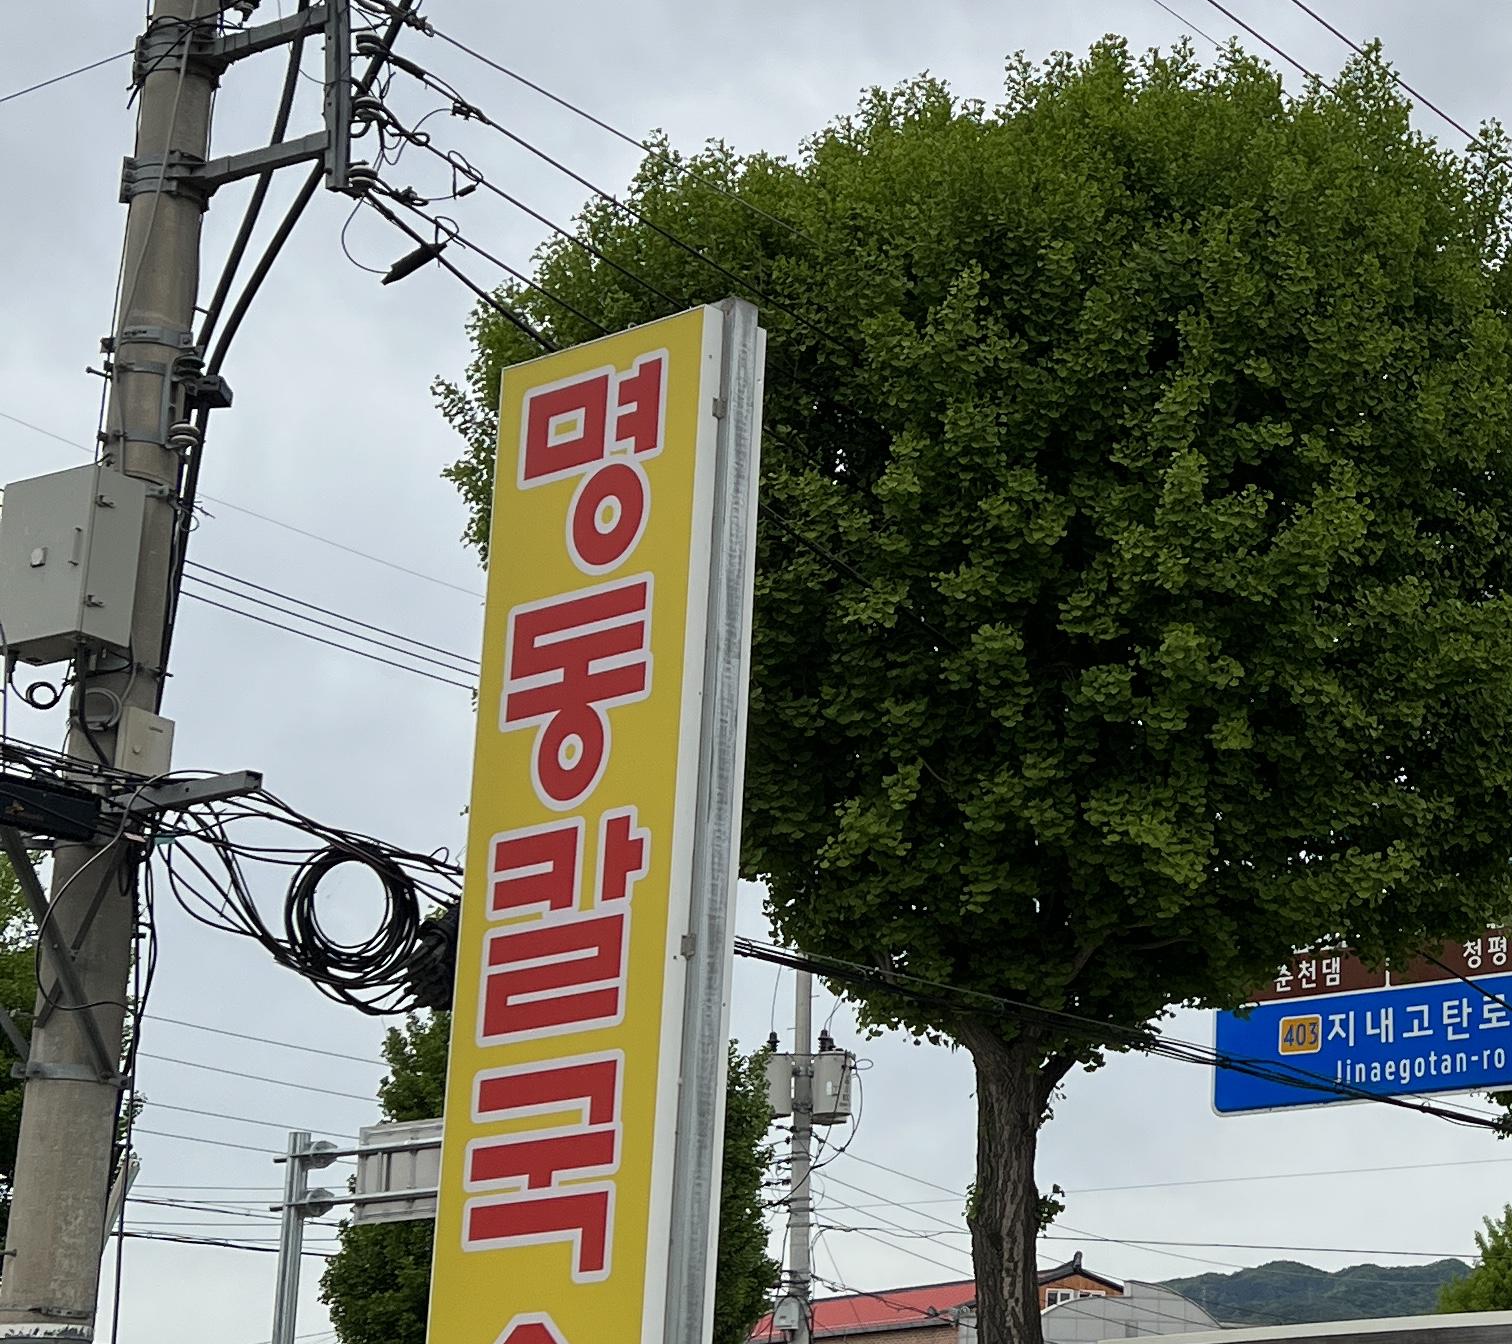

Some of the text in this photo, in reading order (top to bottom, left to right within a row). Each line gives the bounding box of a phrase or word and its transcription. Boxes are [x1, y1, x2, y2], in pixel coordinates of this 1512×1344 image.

[1283, 993, 1511, 1048] 403 지내고탄로
[1334, 1047, 1506, 1084] Jinaegotan-ro
